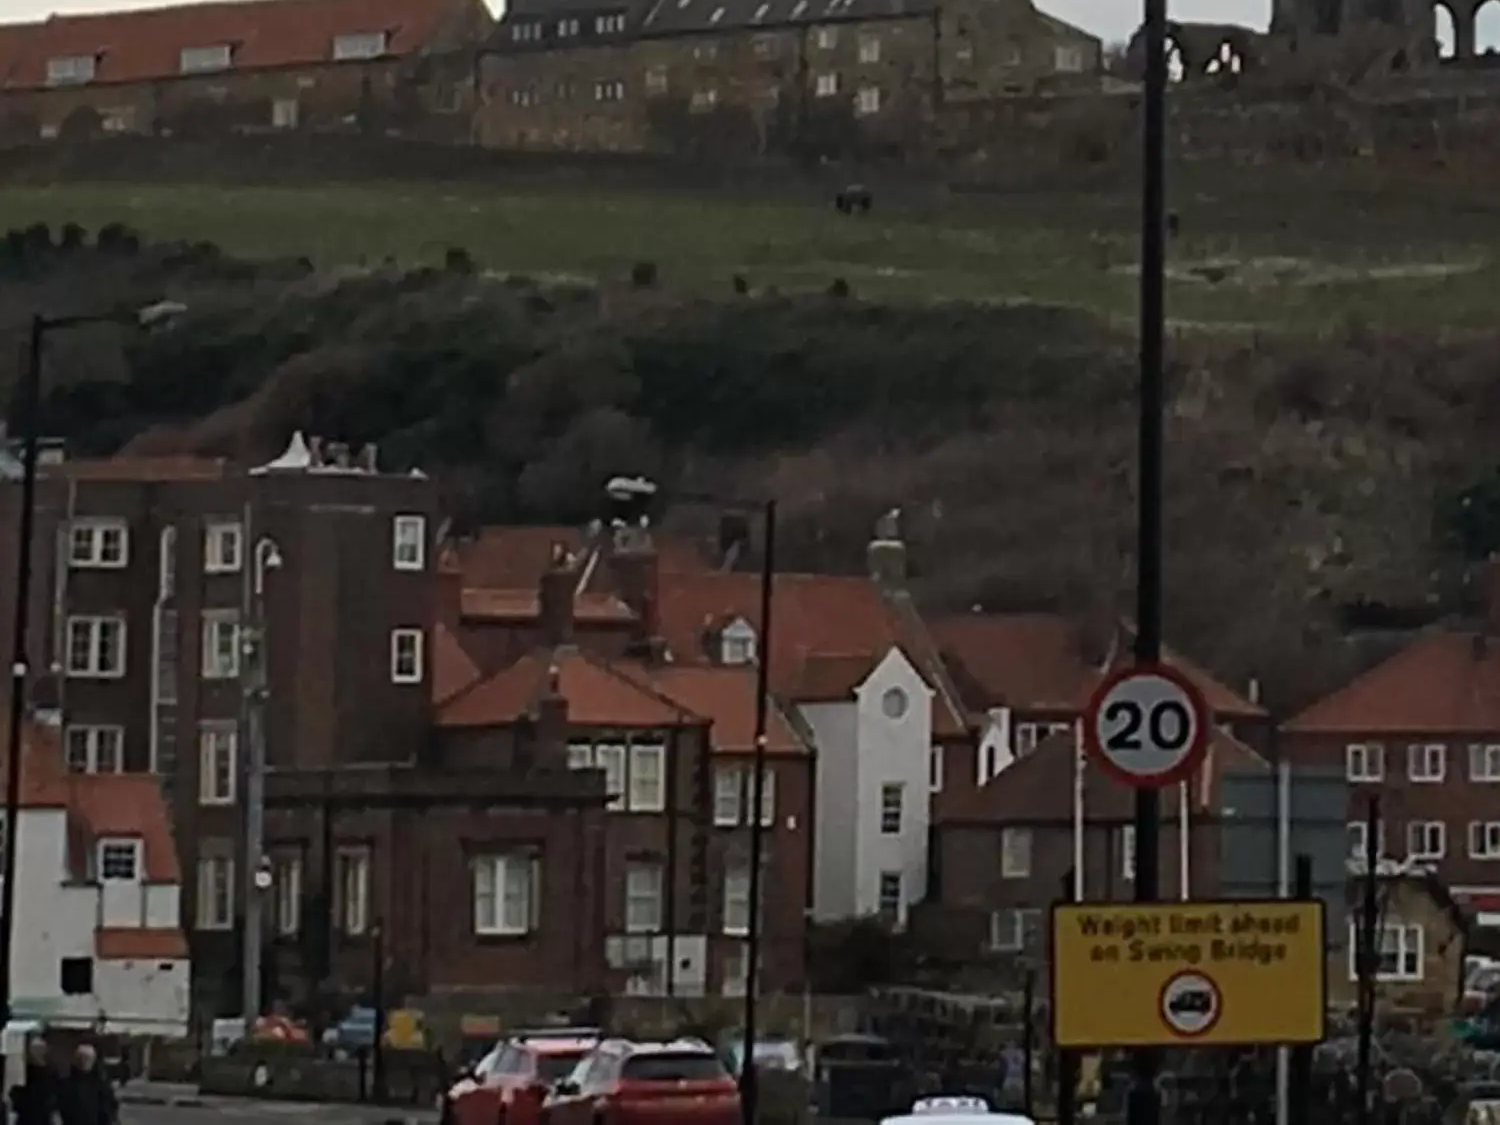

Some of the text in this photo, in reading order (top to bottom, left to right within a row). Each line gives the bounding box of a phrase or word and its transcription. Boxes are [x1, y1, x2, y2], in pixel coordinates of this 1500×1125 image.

[1105, 701, 1190, 751] 20
[1077, 912, 1300, 939] Weight limit ahead
[1128, 940, 1202, 964] Swing
[1211, 939, 1287, 965] Bridge
